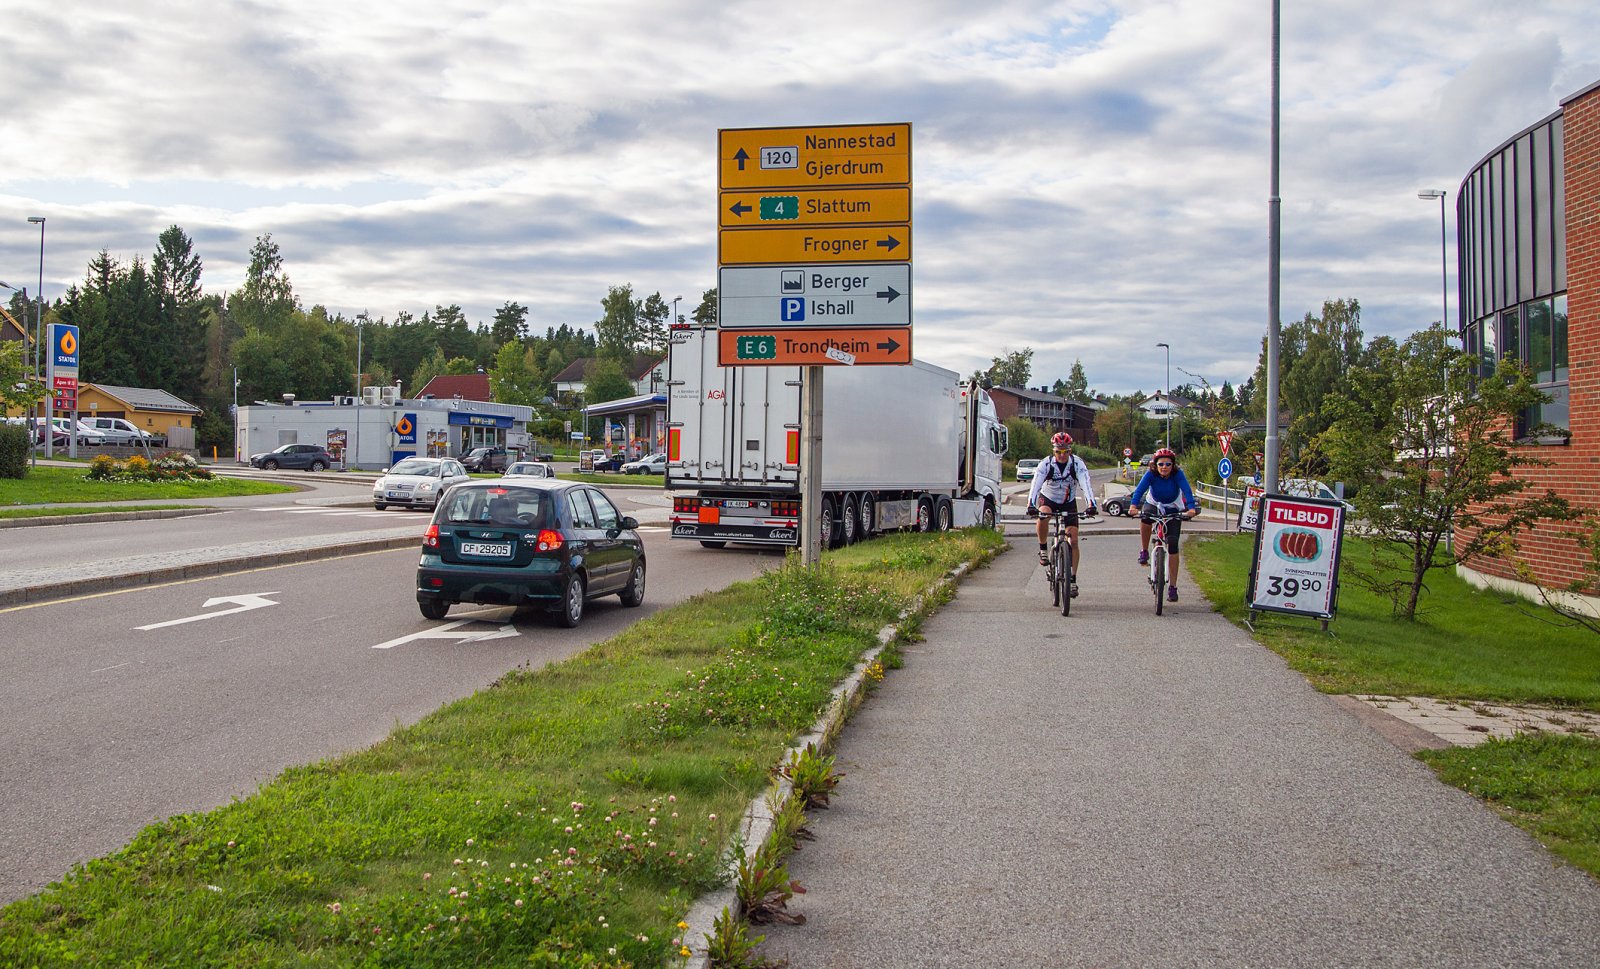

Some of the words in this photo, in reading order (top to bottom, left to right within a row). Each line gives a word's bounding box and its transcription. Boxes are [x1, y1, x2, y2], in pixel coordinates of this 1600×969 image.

[805, 132, 896, 150] Nannestad
[766, 151, 792, 165] 120
[805, 160, 883, 179] Gjerdrum
[774, 201, 785, 215] 4
[806, 199, 871, 214] Slattum
[804, 237, 870, 255] Frogner
[811, 273, 869, 292] Berger
[787, 300, 801, 319] P
[811, 300, 854, 315] Ishall
[745, 341, 753, 354] E
[758, 340, 768, 354] 6
[783, 339, 870, 354] Trondheim
[708, 389, 726, 400] AGA
[1245, 515, 1258, 526] 39
[1274, 507, 1329, 525] TILBUD
[463, 544, 476, 553] CF
[479, 545, 508, 555] 29205
[1266, 575, 1300, 598] 39
[1301, 578, 1322, 592] 90
